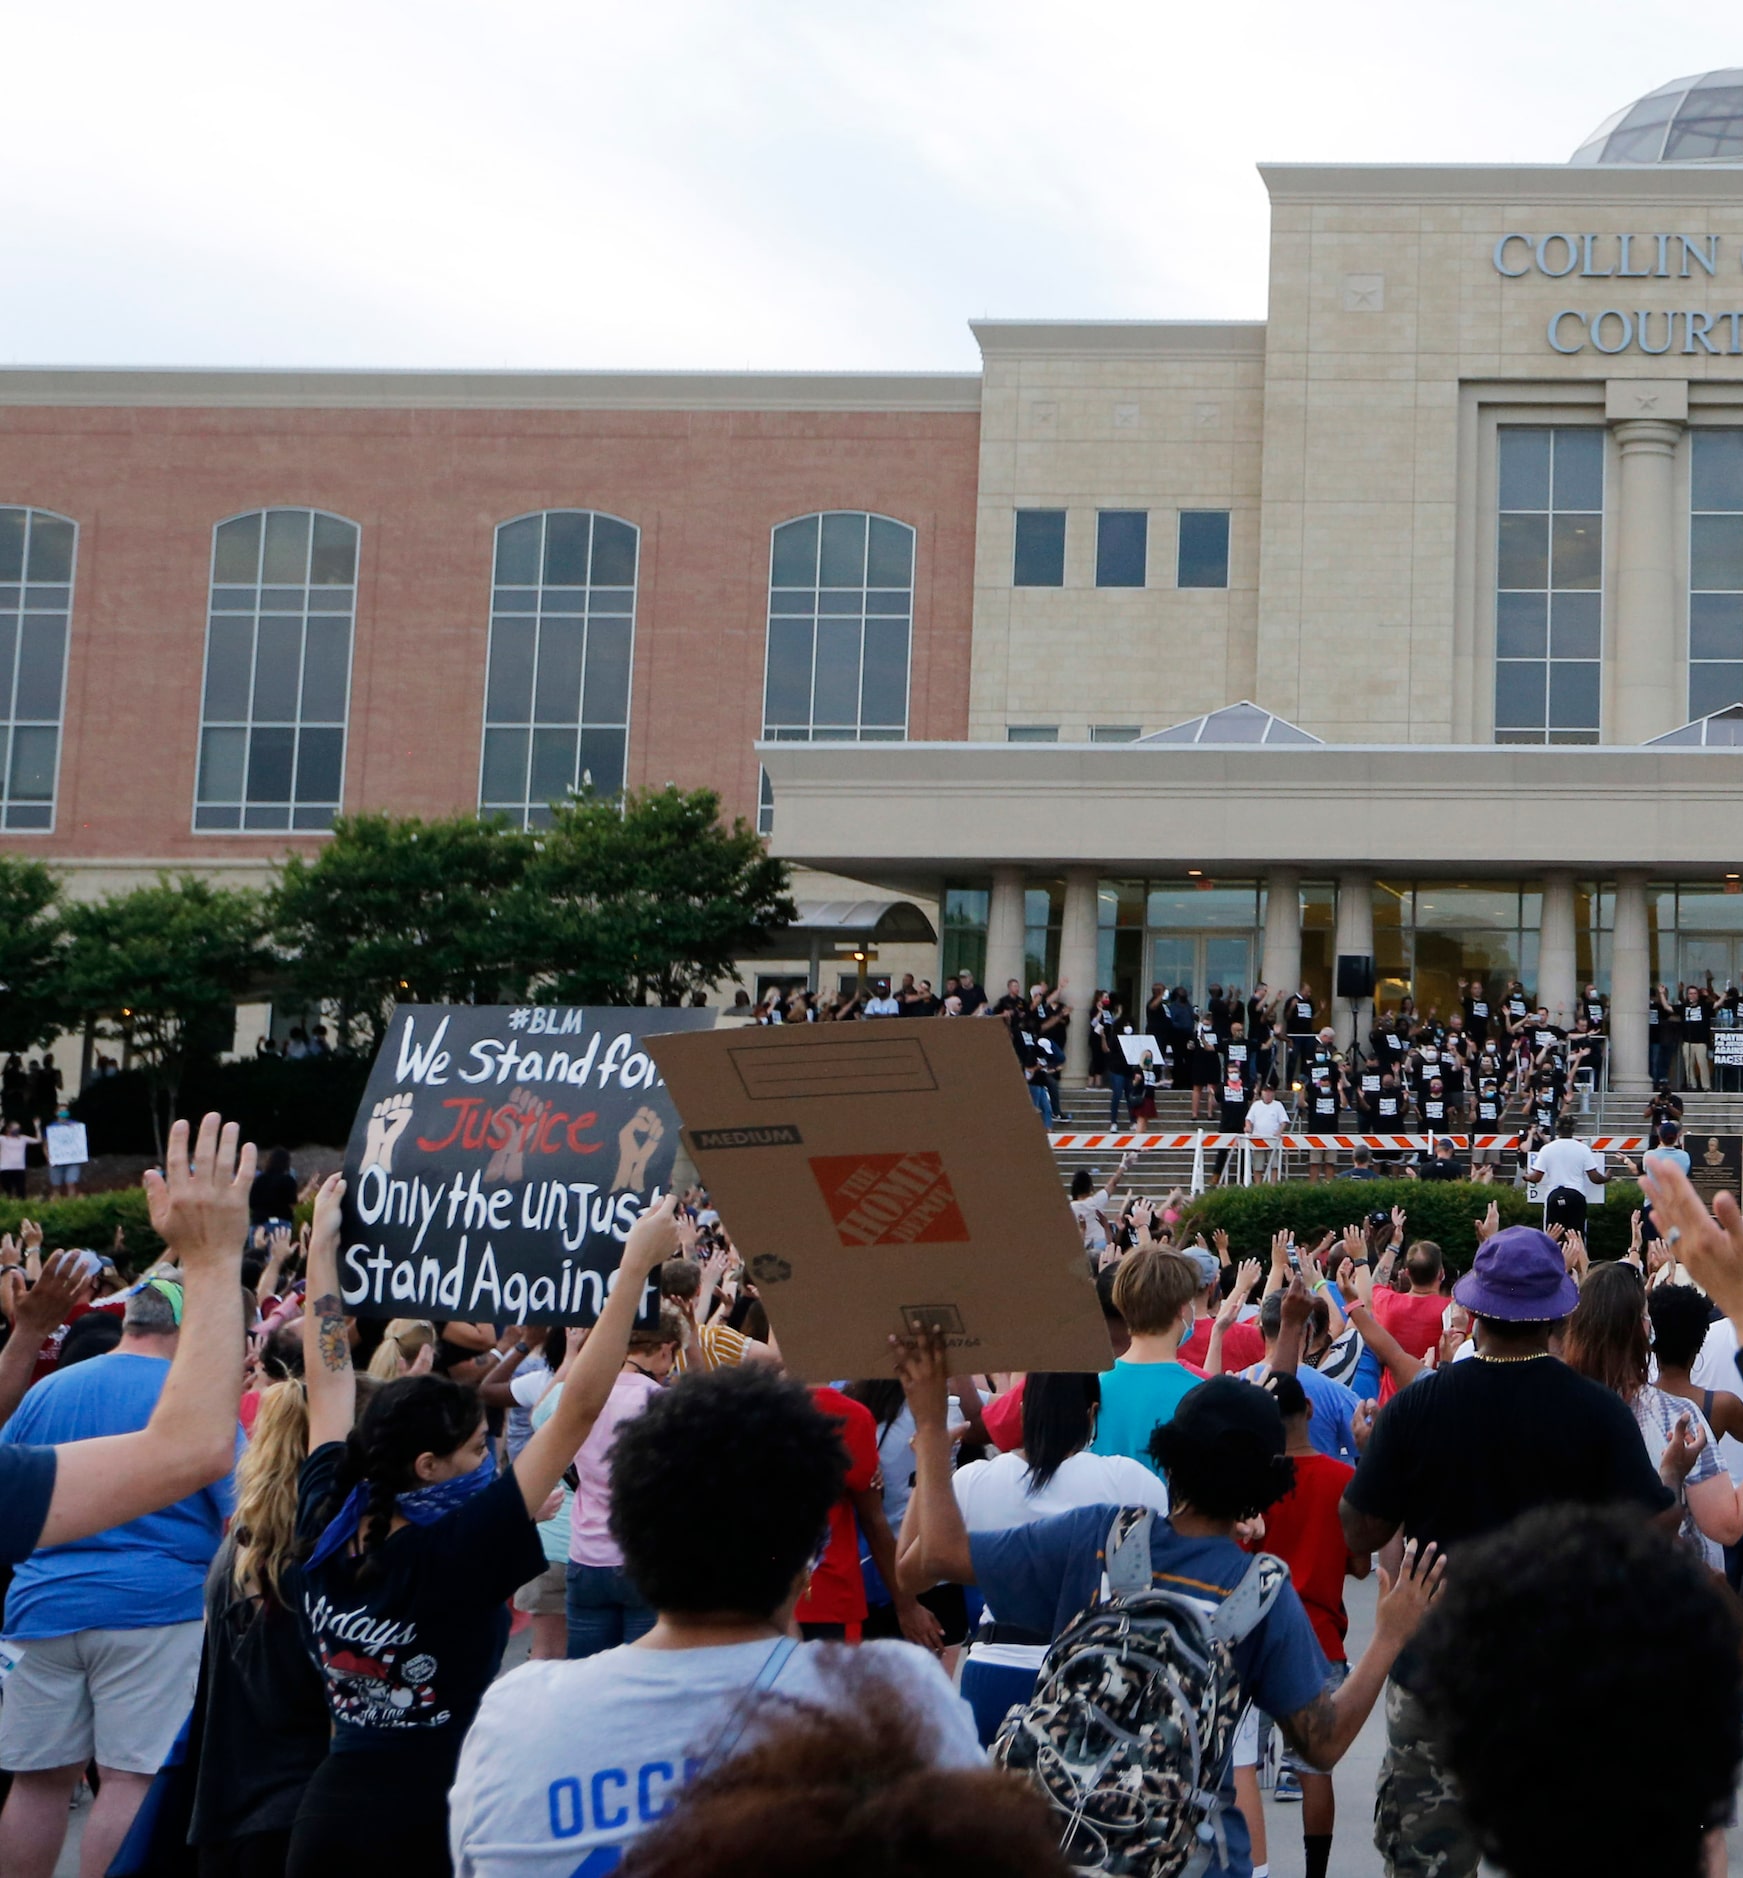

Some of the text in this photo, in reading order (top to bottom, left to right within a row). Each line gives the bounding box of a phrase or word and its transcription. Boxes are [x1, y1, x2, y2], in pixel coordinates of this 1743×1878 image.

[1493, 233, 1721, 277] COLLIN
[508, 1007, 583, 1035] #BLM
[395, 1015, 451, 1086] We
[458, 1031, 601, 1088] Stand
[416, 1097, 604, 1154] Justice
[701, 1129, 794, 1146] MEDIUM
[357, 1163, 446, 1254] Only
[447, 1169, 513, 1230] the
[835, 1164, 881, 1200] THE
[837, 1151, 944, 1246] HOME
[890, 1185, 955, 1243] DEPOT
[341, 1235, 467, 1310] Stand
